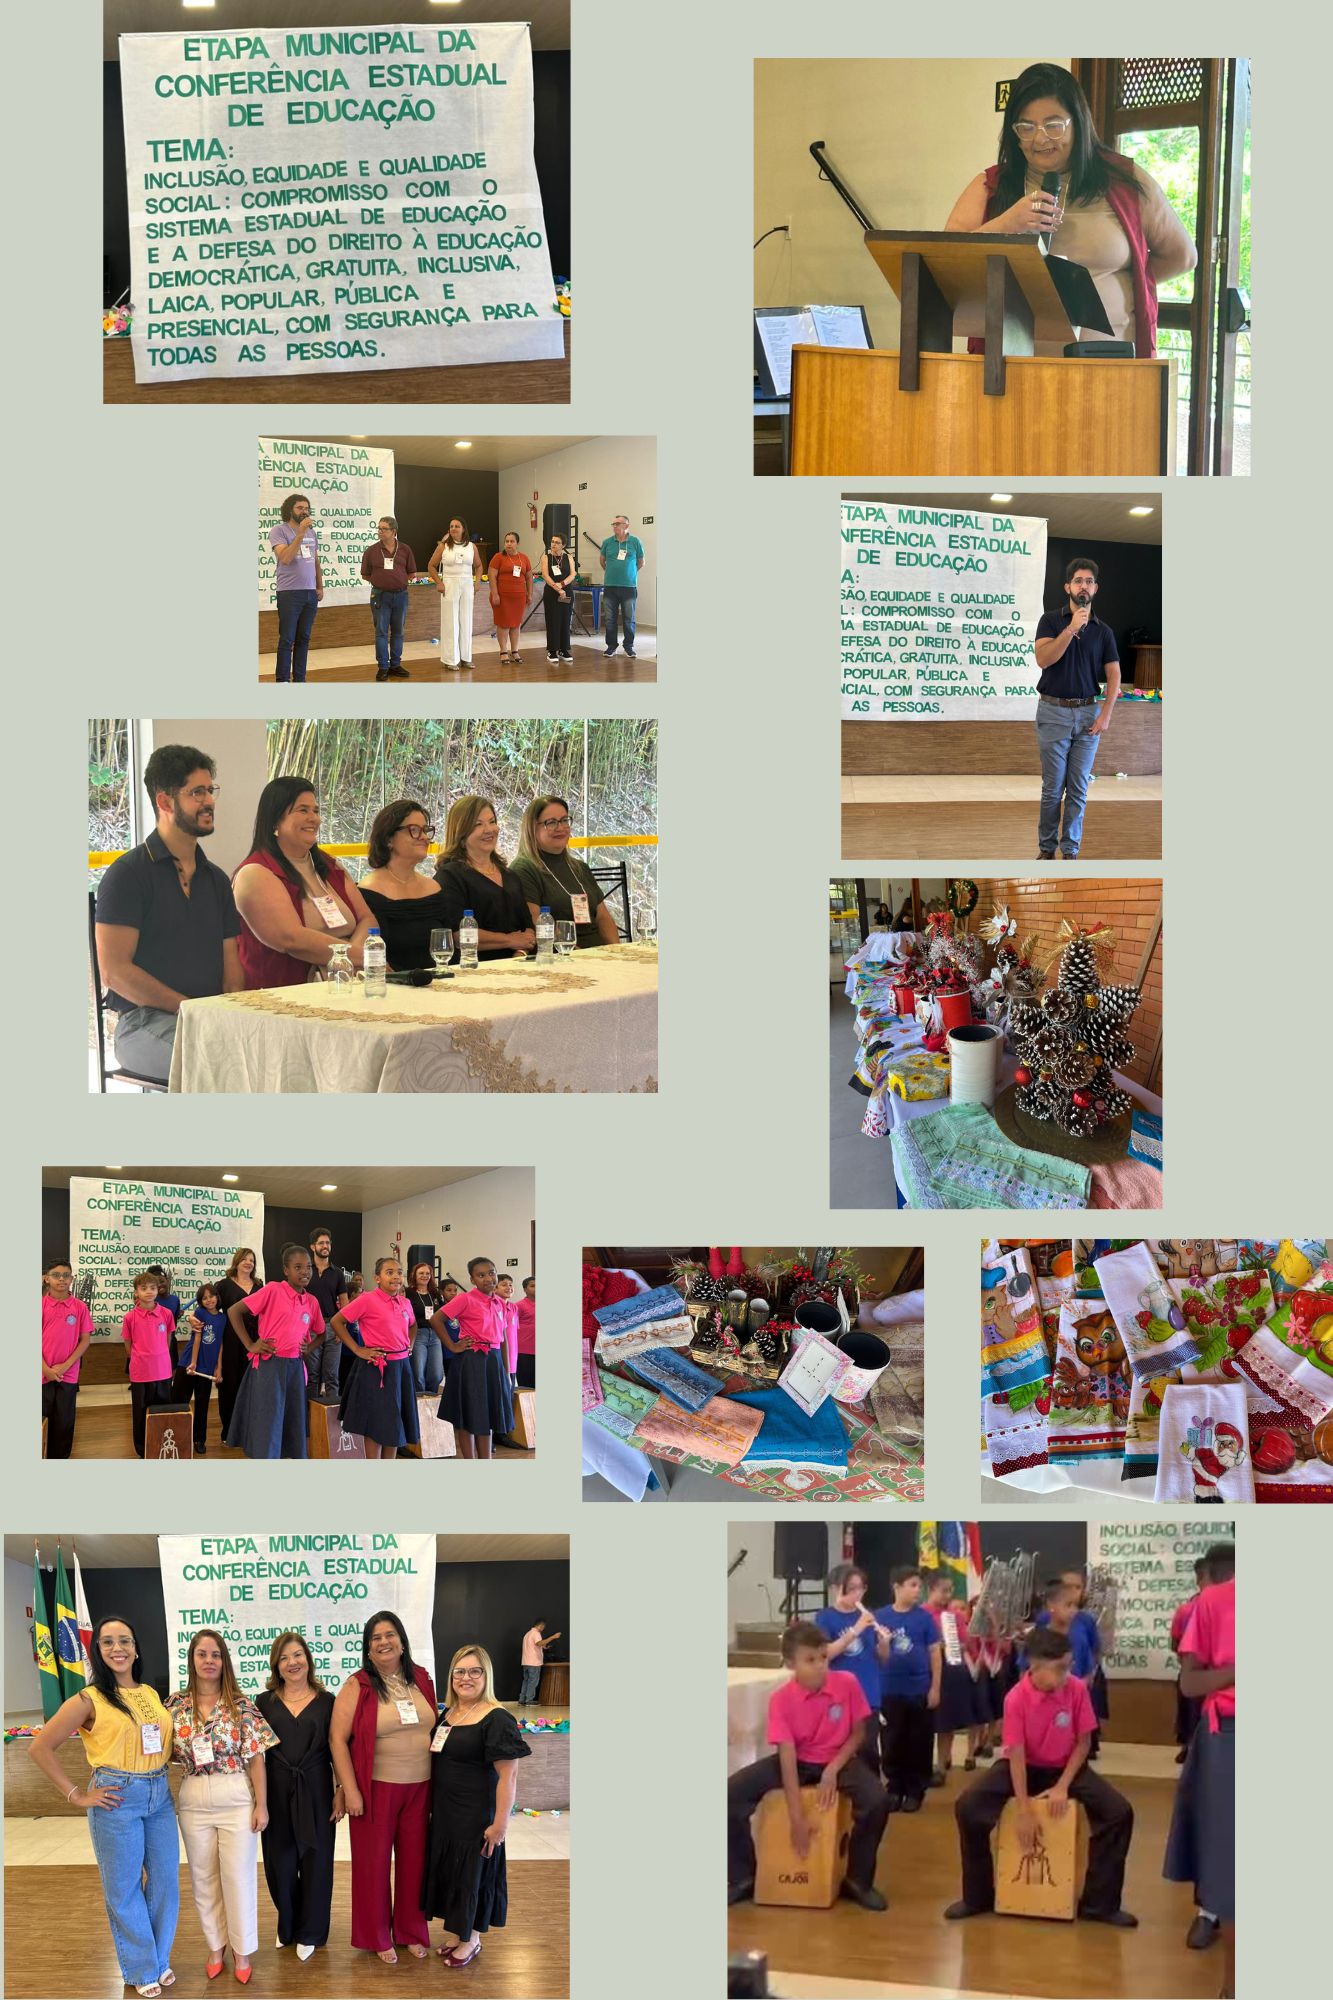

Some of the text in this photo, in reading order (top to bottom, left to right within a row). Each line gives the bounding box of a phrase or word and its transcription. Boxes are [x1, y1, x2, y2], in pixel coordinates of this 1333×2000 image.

[184, 30, 476, 62] ETAPA MUNICIPAL DA
[154, 64, 506, 97] CONFERÊNCIA ESTADUAL
[228, 95, 435, 129] DE EDUCAÇÃO
[147, 138, 235, 162] TEMA:
[144, 152, 486, 189] INCLUSÃO, EQUIDADE E QUALIDADE
[241, 184, 388, 210] COMPROMISSO
[406, 180, 450, 198] COM
[483, 179, 497, 196] O
[146, 200, 506, 239] SISTEMA ESTADUAL DE EDUCAÇÃO
[148, 225, 542, 264] E A DEFESA DO DIREITO À EDUCAÇÃO
[148, 255, 521, 289] DEMOCRÁTICA, GRATUITA, INCLUSIVA,
[149, 280, 454, 314] LAICA, POPULAR, PÚBLICA E
[147, 302, 538, 339] PRESENCIAL, COM SEGURANÇA PARA
[147, 340, 386, 366] TODAS AS PESSOAS.
[273, 442, 344, 458] MUNICIPAL
[351, 449, 368, 460] DA
[316, 462, 382, 478] ESTADUAL
[273, 476, 348, 494] EDUCAÇÃO
[320, 508, 372, 517] QUALIDADE
[841, 505, 1015, 532] TAPA MUNICIPAL DA
[333, 520, 354, 528] COM
[336, 542, 342, 552] À
[949, 534, 1031, 555] ESTADUAL
[857, 549, 988, 575] DE EDUCAÇÃO
[871, 591, 931, 602] EQUIDADE
[938, 593, 944, 603] E
[951, 593, 1015, 604] QUALIDADE
[862, 606, 955, 618] COMPROMISSO
[966, 609, 992, 619] COM
[1012, 611, 1020, 620] O
[863, 621, 928, 631] ESTADUAL
[937, 622, 951, 633] DE
[962, 623, 1024, 638] EDUCAÇÃO
[889, 637, 908, 647] DO
[916, 636, 960, 649] DIREITO
[967, 636, 976, 650] À
[982, 640, 1034, 655] EDUCAÇÃ
[900, 652, 962, 665] GRATUITA,
[969, 655, 1029, 667] INCLUSIVA,
[844, 666, 990, 681] POPULAR, PÚBLICA E
[884, 685, 912, 696] COM
[921, 686, 997, 698] SEGURANÇA
[1005, 686, 1037, 696] PARA
[852, 701, 944, 713] AS PESSOAS.
[103, 1182, 240, 1202] ETAPA MUNICIPAL DA
[87, 1198, 253, 1219] CONFERÊNCIA ESTADUAL
[123, 1215, 221, 1234] DE EDUCAÇÃO
[81, 1229, 125, 1241] TEMA:
[134, 1245, 179, 1254] EQUIDADE
[185, 1246, 190, 1254] E
[127, 1256, 198, 1265] COMPROMISSO
[78, 1268, 121, 1276] SISTEMA
[185, 1268, 196, 1276] DE
[201, 1534, 398, 1555] ETAPA MUNICIPAL DA
[183, 1556, 418, 1580] CONFERÊNCIA ESTADUAL
[230, 1579, 368, 1604] DE EDUCAÇÃO
[178, 1609, 234, 1625] TEMA:
[315, 1626, 322, 1636] E
[345, 1641, 363, 1652] CO
[240, 1660, 271, 1672] ESTA
